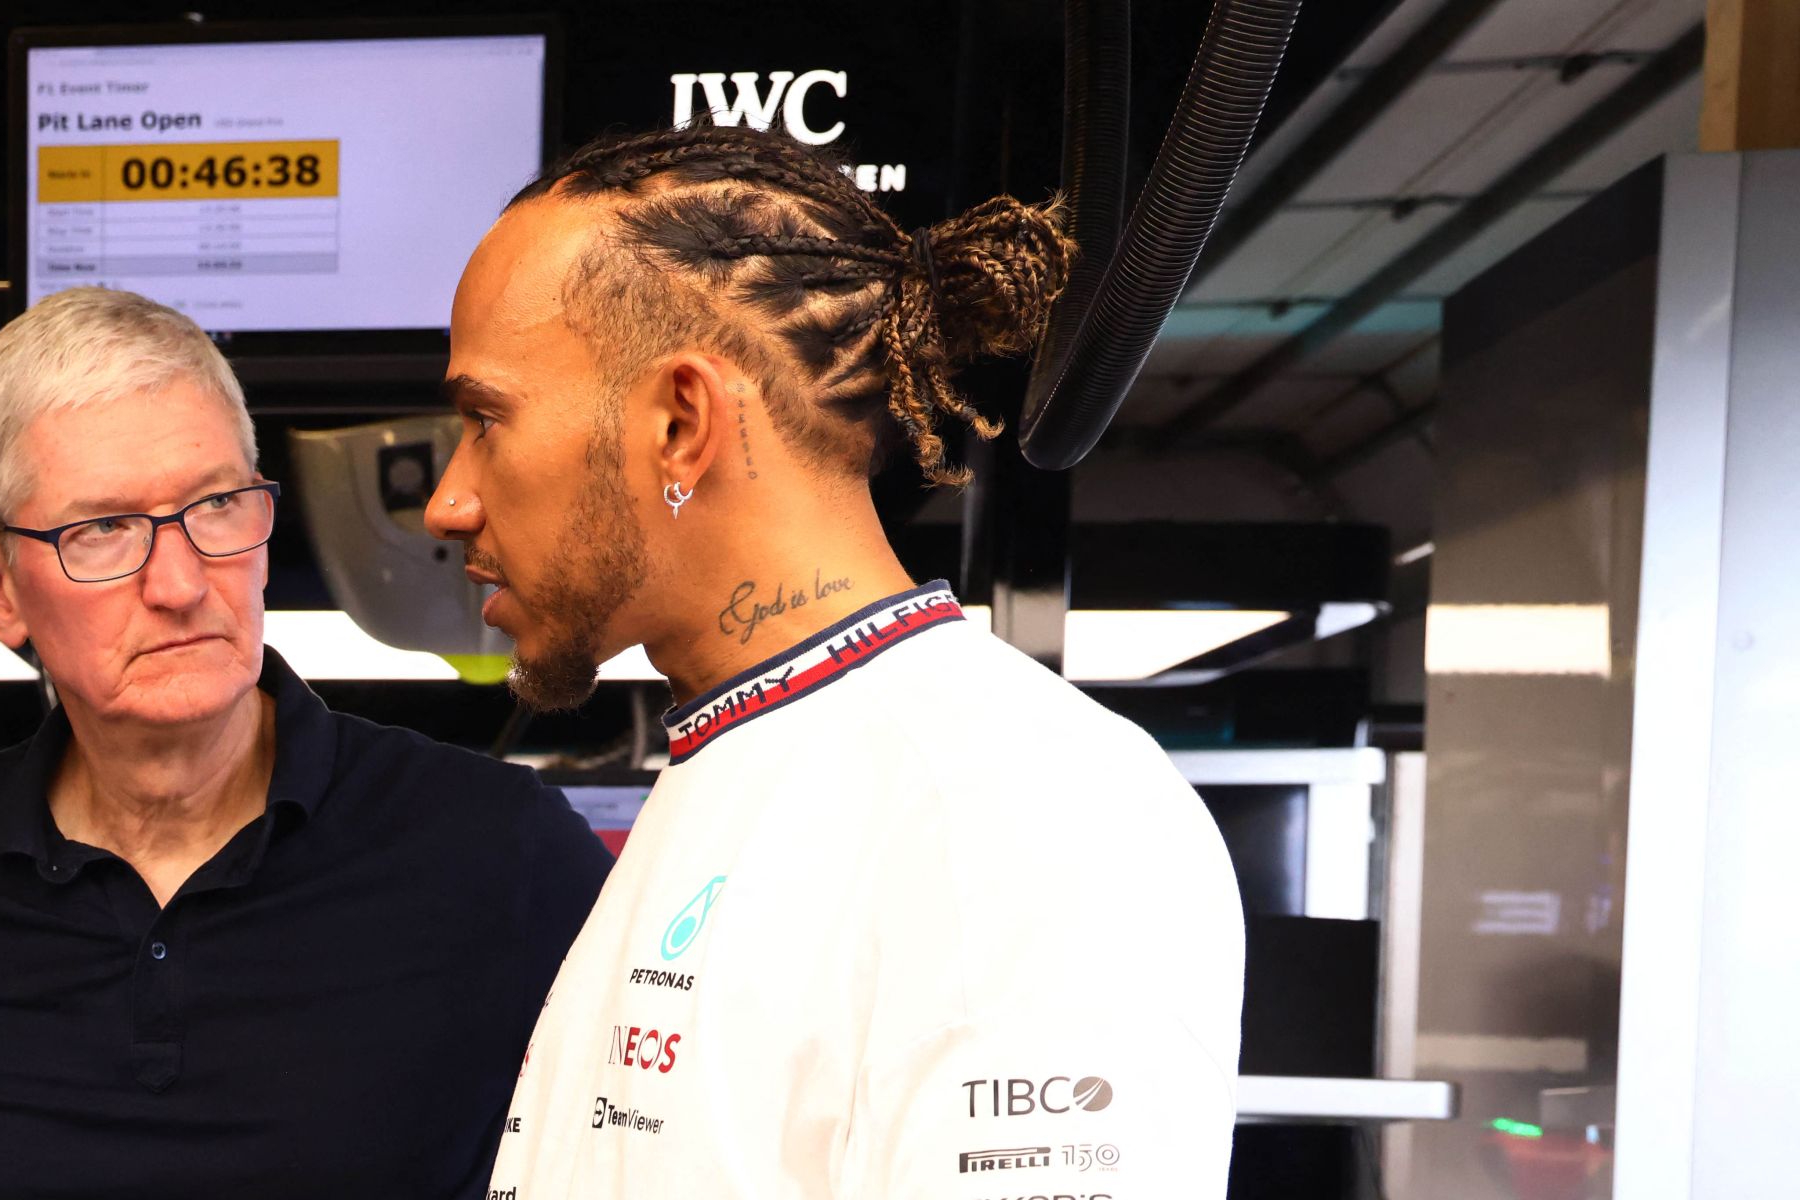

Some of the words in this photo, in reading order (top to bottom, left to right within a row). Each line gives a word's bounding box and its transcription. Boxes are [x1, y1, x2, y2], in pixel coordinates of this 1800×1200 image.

[37, 113, 69, 132] Pit
[77, 112, 132, 131] Lane
[140, 110, 202, 133] Open
[670, 69, 847, 146] IWC
[121, 155, 321, 190] 00:46:38
[718, 580, 786, 646] God
[791, 588, 809, 609] is
[814, 568, 855, 602] love
[678, 666, 794, 746] TOMMY
[629, 968, 695, 991] PETRONAS
[608, 1025, 682, 1074] INEOS
[961, 1076, 1114, 1118] TIBCO
[959, 1146, 1052, 1174] PIRELLI
